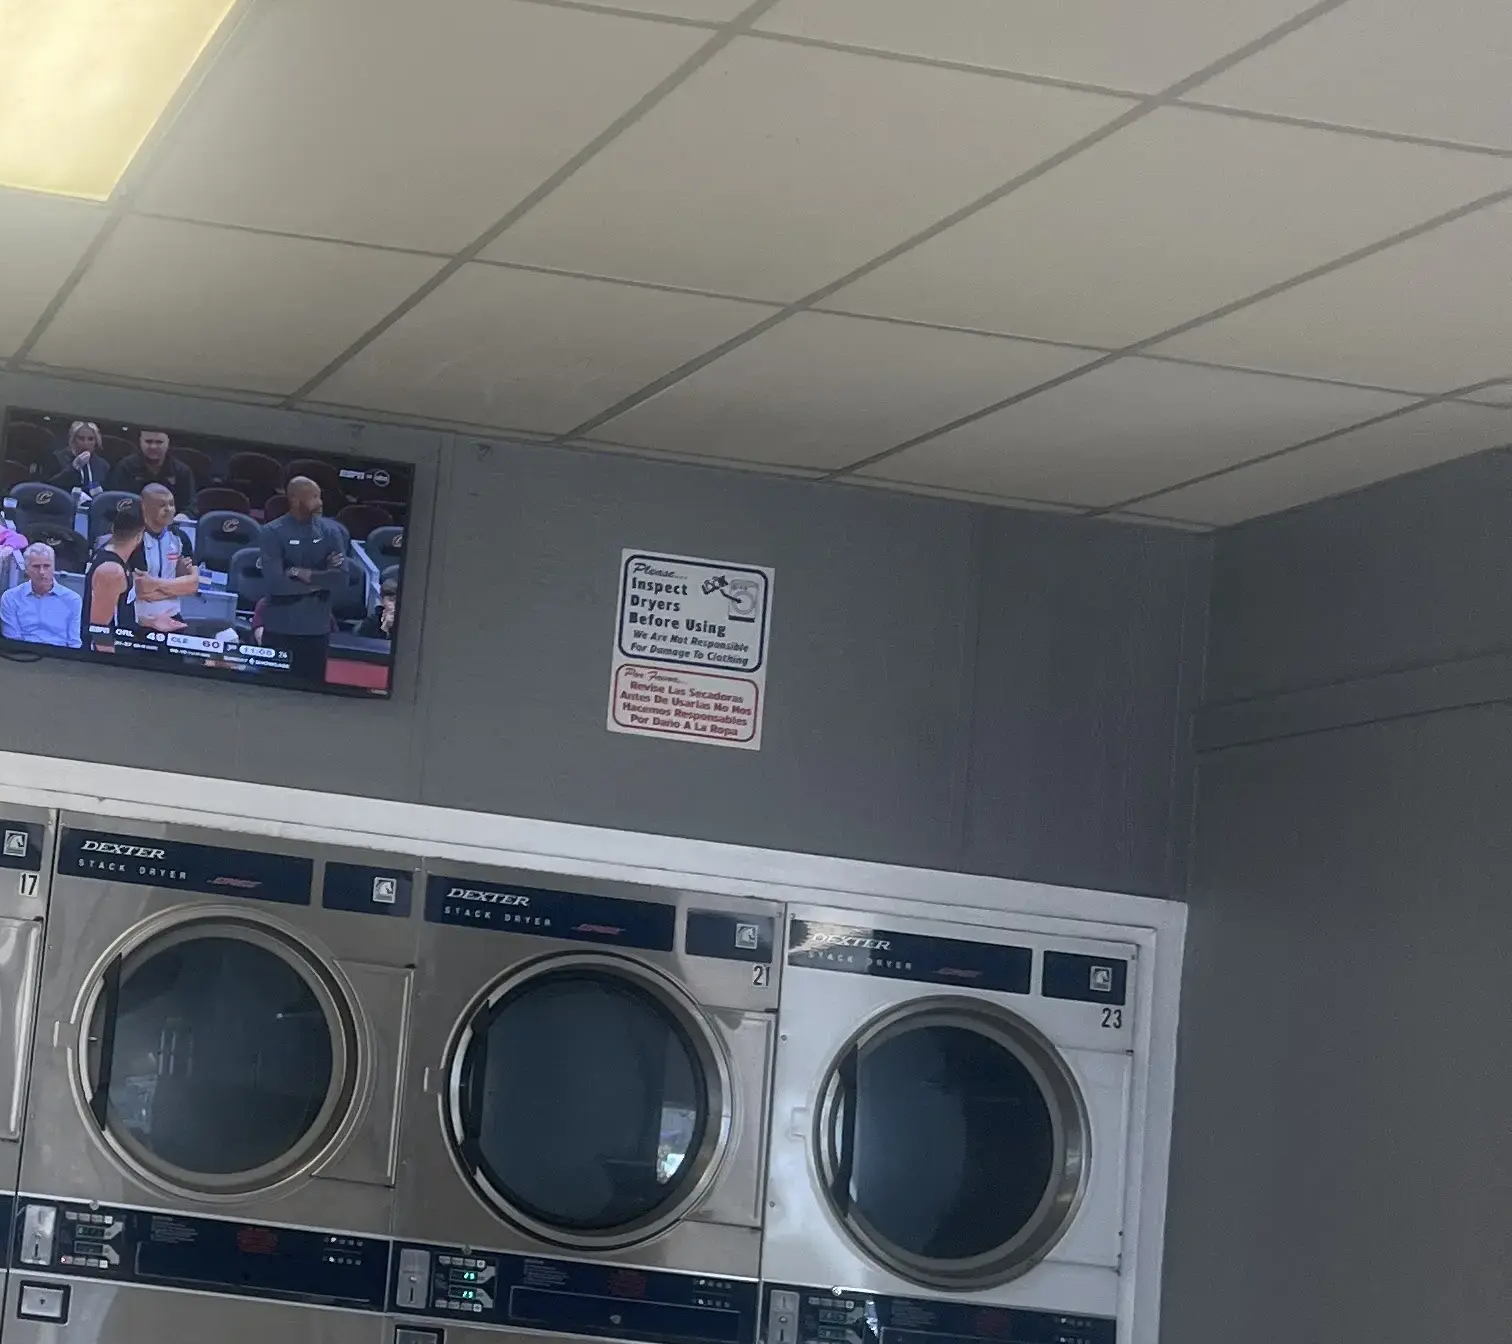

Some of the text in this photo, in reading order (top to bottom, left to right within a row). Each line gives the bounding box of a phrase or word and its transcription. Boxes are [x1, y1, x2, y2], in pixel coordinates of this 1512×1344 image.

[631, 576, 688, 596] Inspect
[630, 594, 681, 612] Dryers
[629, 611, 726, 638] Before Using
[633, 629, 749, 653] We Are Not Responsible
[630, 642, 749, 667] For Damage To Clothing
[620, 690, 651, 703] Antes
[654, 695, 669, 706] De
[713, 702, 730, 713] No
[732, 705, 752, 716] Nos
[630, 681, 744, 704] Revise Las Secadoras
[622, 702, 748, 727] Hacemos Responsables
[630, 714, 650, 725] Por
[683, 721, 691, 730] A
[694, 722, 707, 733] La
[710, 724, 739, 737] Ropa
[81, 840, 167, 860] DEXTER
[78, 858, 187, 880] STACK DRYER
[20, 873, 38, 895] 17
[446, 887, 530, 907] DEXTER
[444, 905, 552, 927] STACK DRYER
[813, 932, 892, 951] DEXTER
[752, 966, 771, 987] 21
[1101, 1007, 1122, 1029] 23
